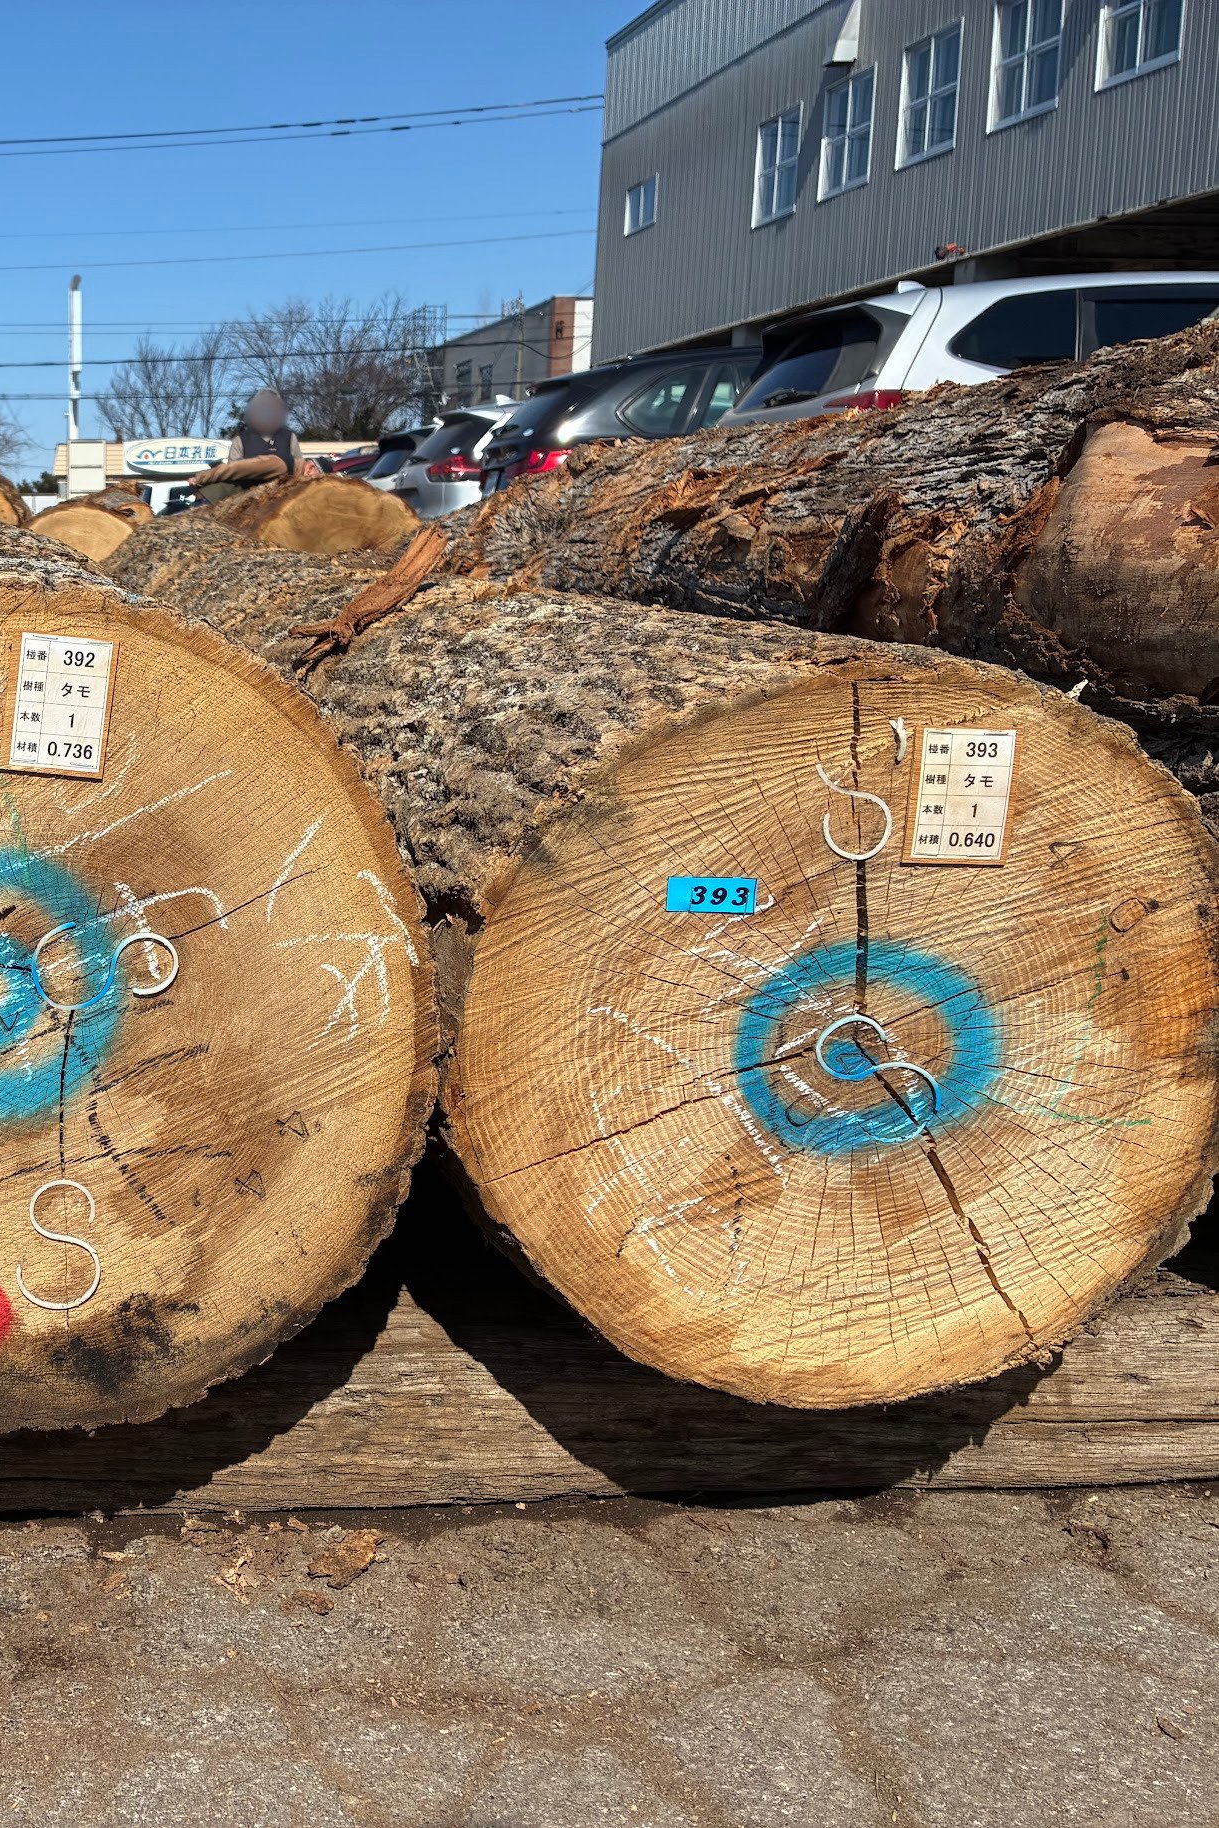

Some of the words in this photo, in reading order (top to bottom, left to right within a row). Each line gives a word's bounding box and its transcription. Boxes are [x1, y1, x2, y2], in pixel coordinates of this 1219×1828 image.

[63, 650, 95, 668] 392
[22, 680, 44, 692] 樹種
[61, 683, 90, 698] タモ
[19, 711, 41, 723] 本数
[68, 713, 75, 728] 1
[16, 741, 38, 753] 材積
[47, 742, 93, 760] 0.736
[965, 742, 998, 758] 393
[925, 774, 946, 785] 樹種
[964, 774, 993, 788] タモ
[922, 804, 943, 815] 本数
[971, 803, 978, 818] 1
[918, 835, 939, 845] 材積
[948, 832, 995, 847] 0.640
[691, 885, 750, 906] 393
